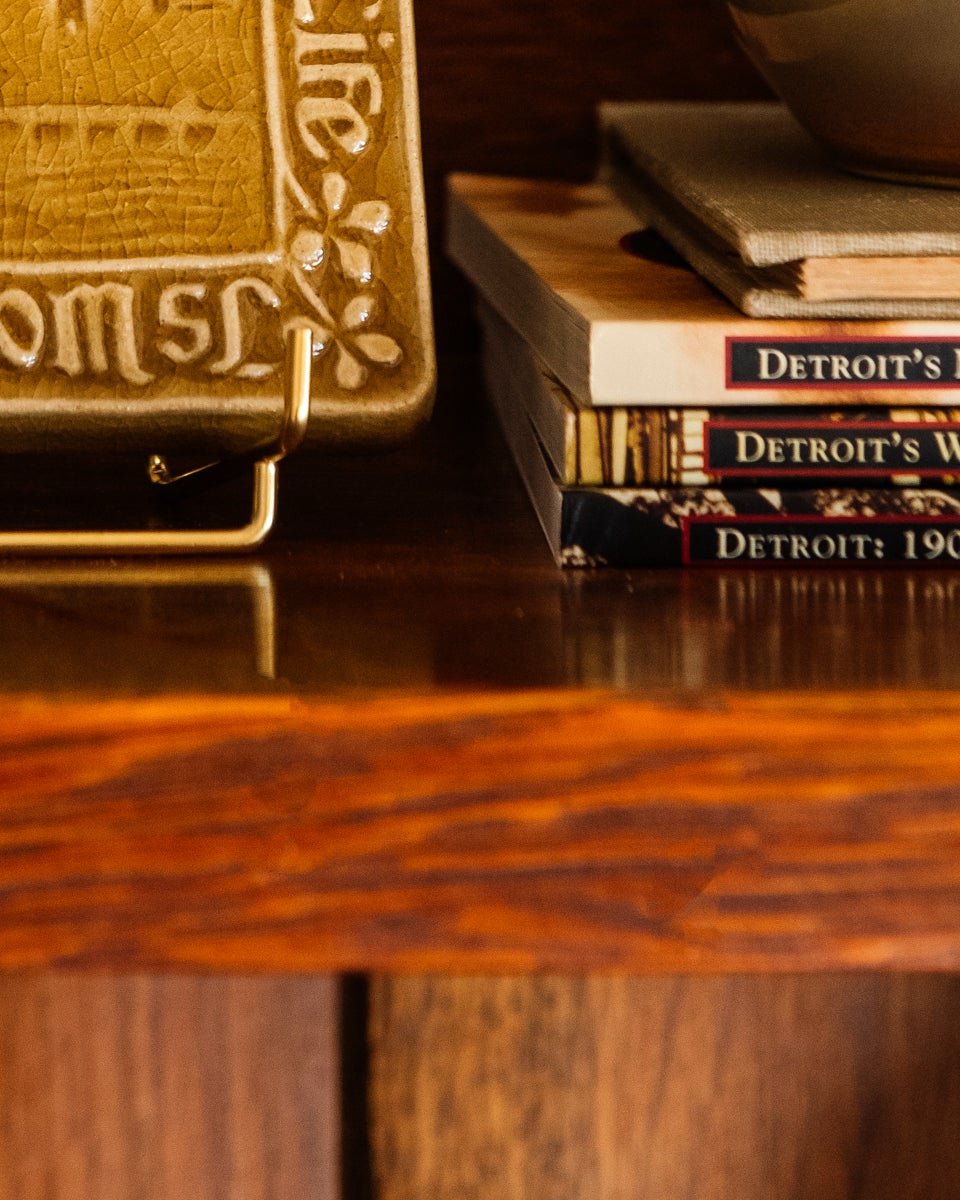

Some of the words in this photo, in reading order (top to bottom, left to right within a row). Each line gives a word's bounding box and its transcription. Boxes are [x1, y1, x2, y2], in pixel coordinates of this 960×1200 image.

[757, 346, 941, 381] DETROIT'S
[735, 430, 920, 464] DETROIT'S
[715, 528, 886, 560] DETROIT:
